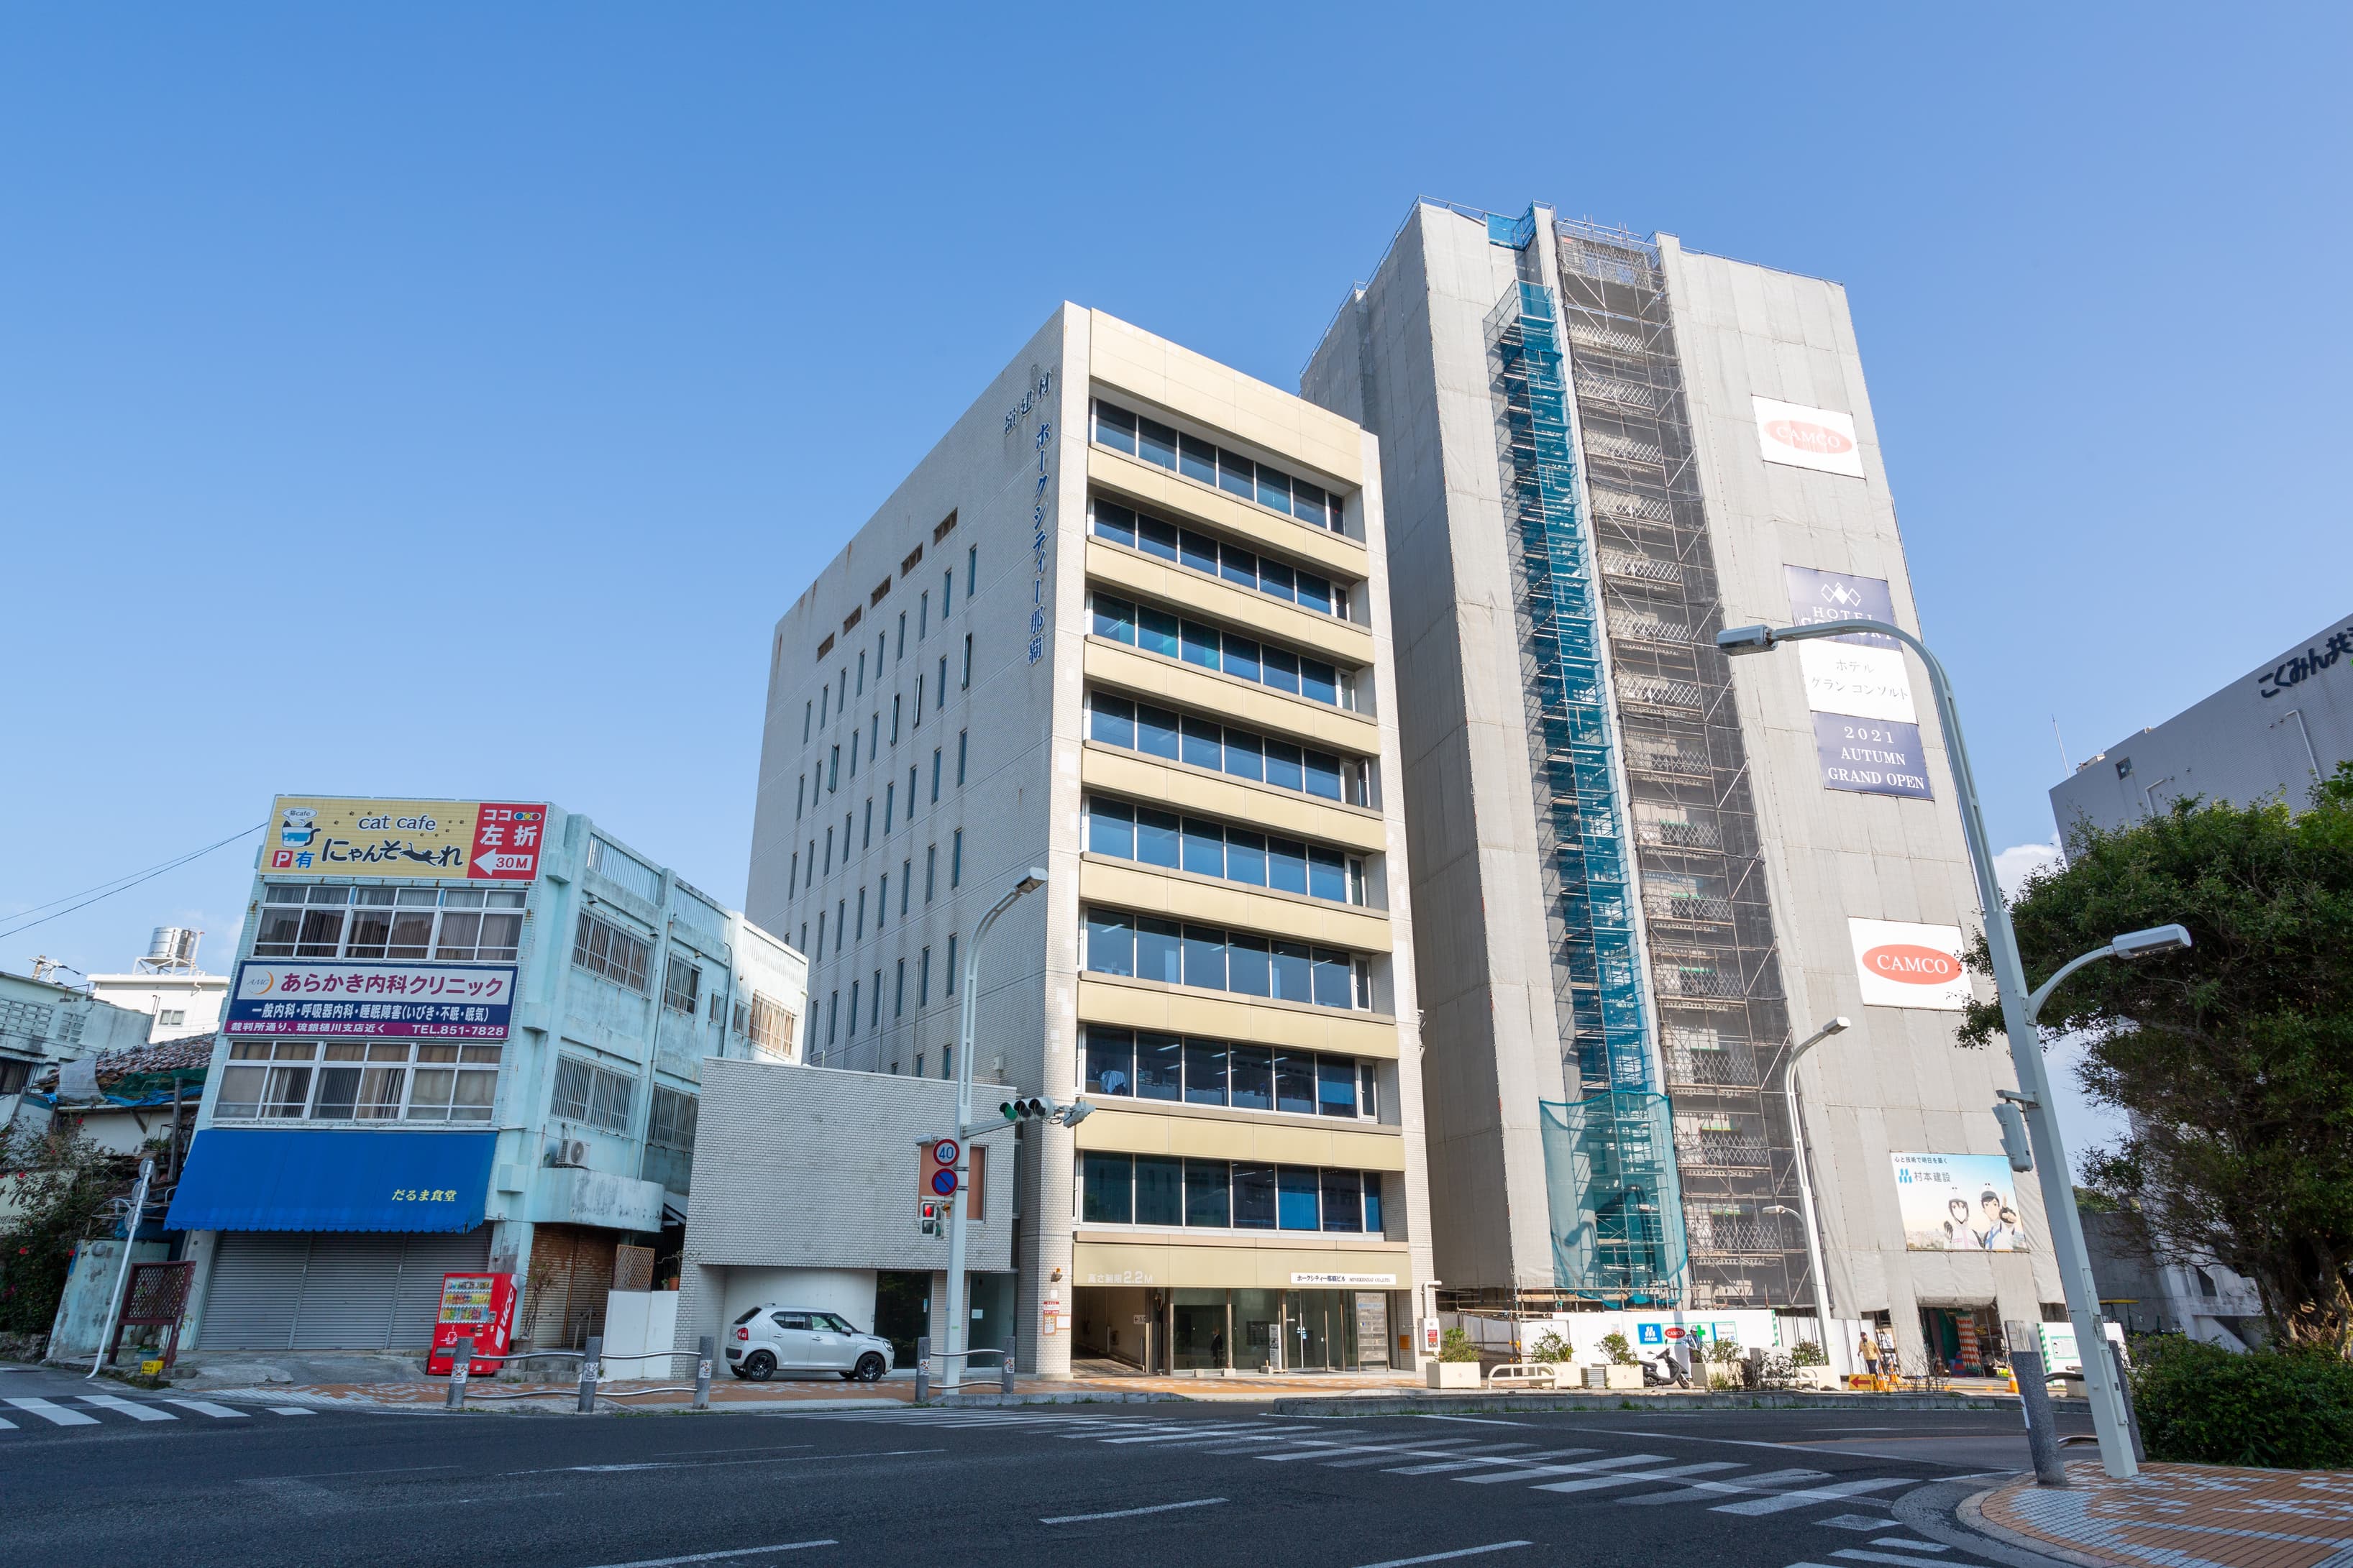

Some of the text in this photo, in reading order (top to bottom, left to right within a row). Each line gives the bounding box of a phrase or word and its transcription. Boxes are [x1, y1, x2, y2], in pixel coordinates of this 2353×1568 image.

[1777, 426, 1841, 449] CAMCO
[1028, 422, 1051, 665] ホークシティー那覇
[1836, 659, 1875, 674] ホテル
[2257, 627, 2353, 698] こくみん共
[1844, 726, 1895, 743] 2021
[1841, 747, 1906, 766] AUTUMN
[1828, 768, 1925, 789] GRAND OPEN
[358, 815, 437, 831] cat cafe
[483, 809, 511, 822] ココ
[480, 825, 537, 847] 左折
[495, 856, 529, 869] 30M
[1876, 954, 1949, 974] CAMCO
[280, 972, 503, 997] あらかき内科クリニック
[412, 1024, 504, 1036] TEL.851-7828
[938, 1147, 953, 1159] 40
[1914, 1170, 1951, 1183] 村本建設
[391, 1189, 457, 1202] だるま食堂
